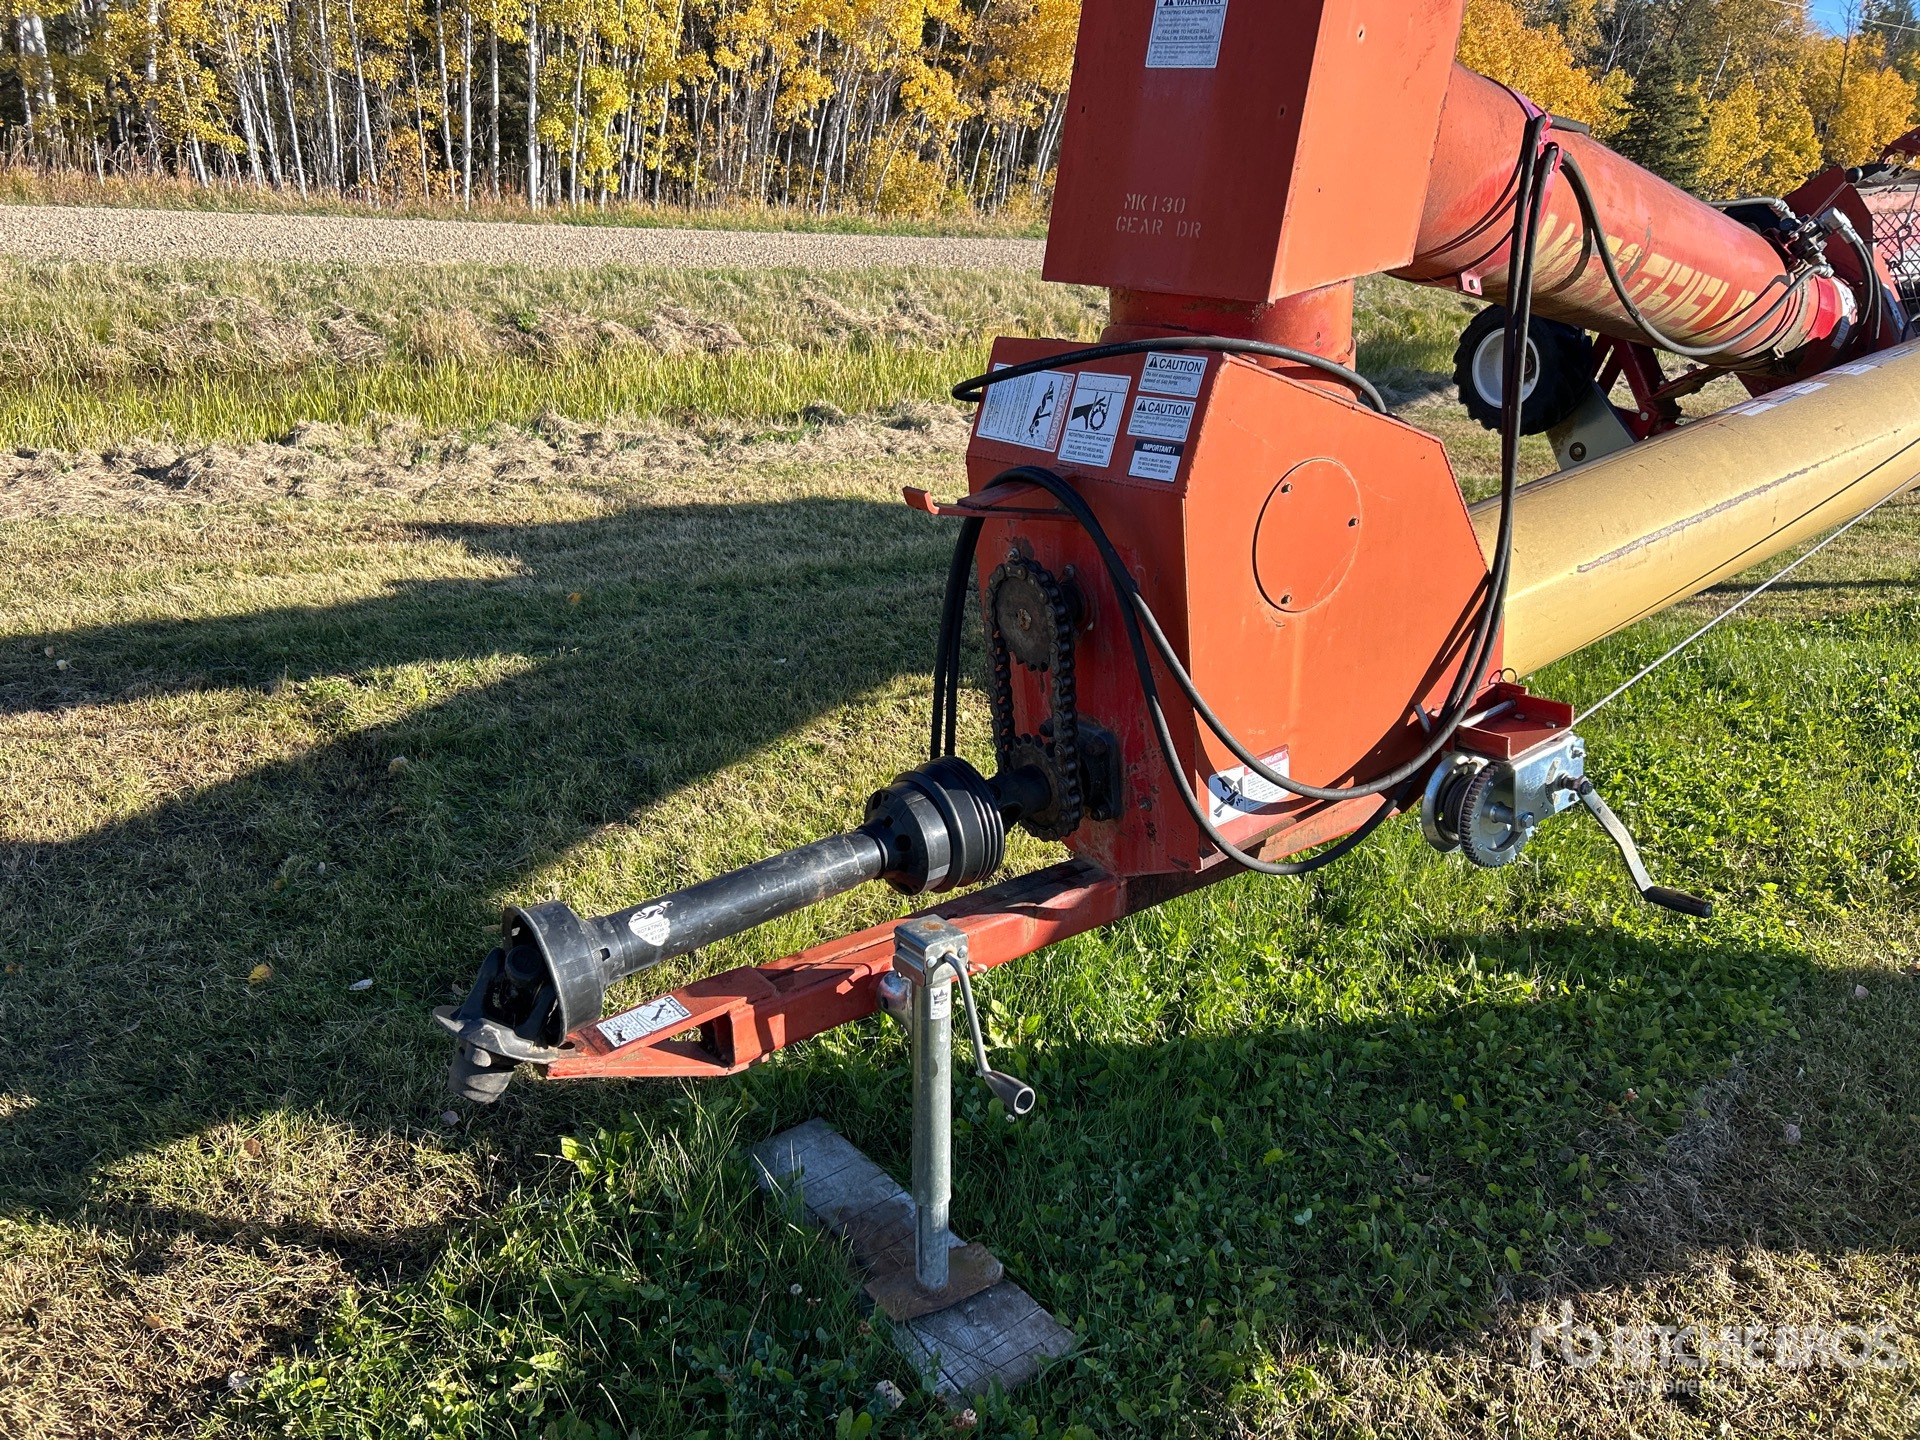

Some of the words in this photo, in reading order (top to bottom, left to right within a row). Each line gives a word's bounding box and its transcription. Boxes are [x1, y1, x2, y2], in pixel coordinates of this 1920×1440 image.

[1116, 216, 1163, 235] GEAR
[1176, 220, 1202, 239] DR
[1160, 358, 1202, 372] CAUTION
[1148, 402, 1190, 416] CAUTION
[1142, 443, 1172, 453] IMPORTANT
